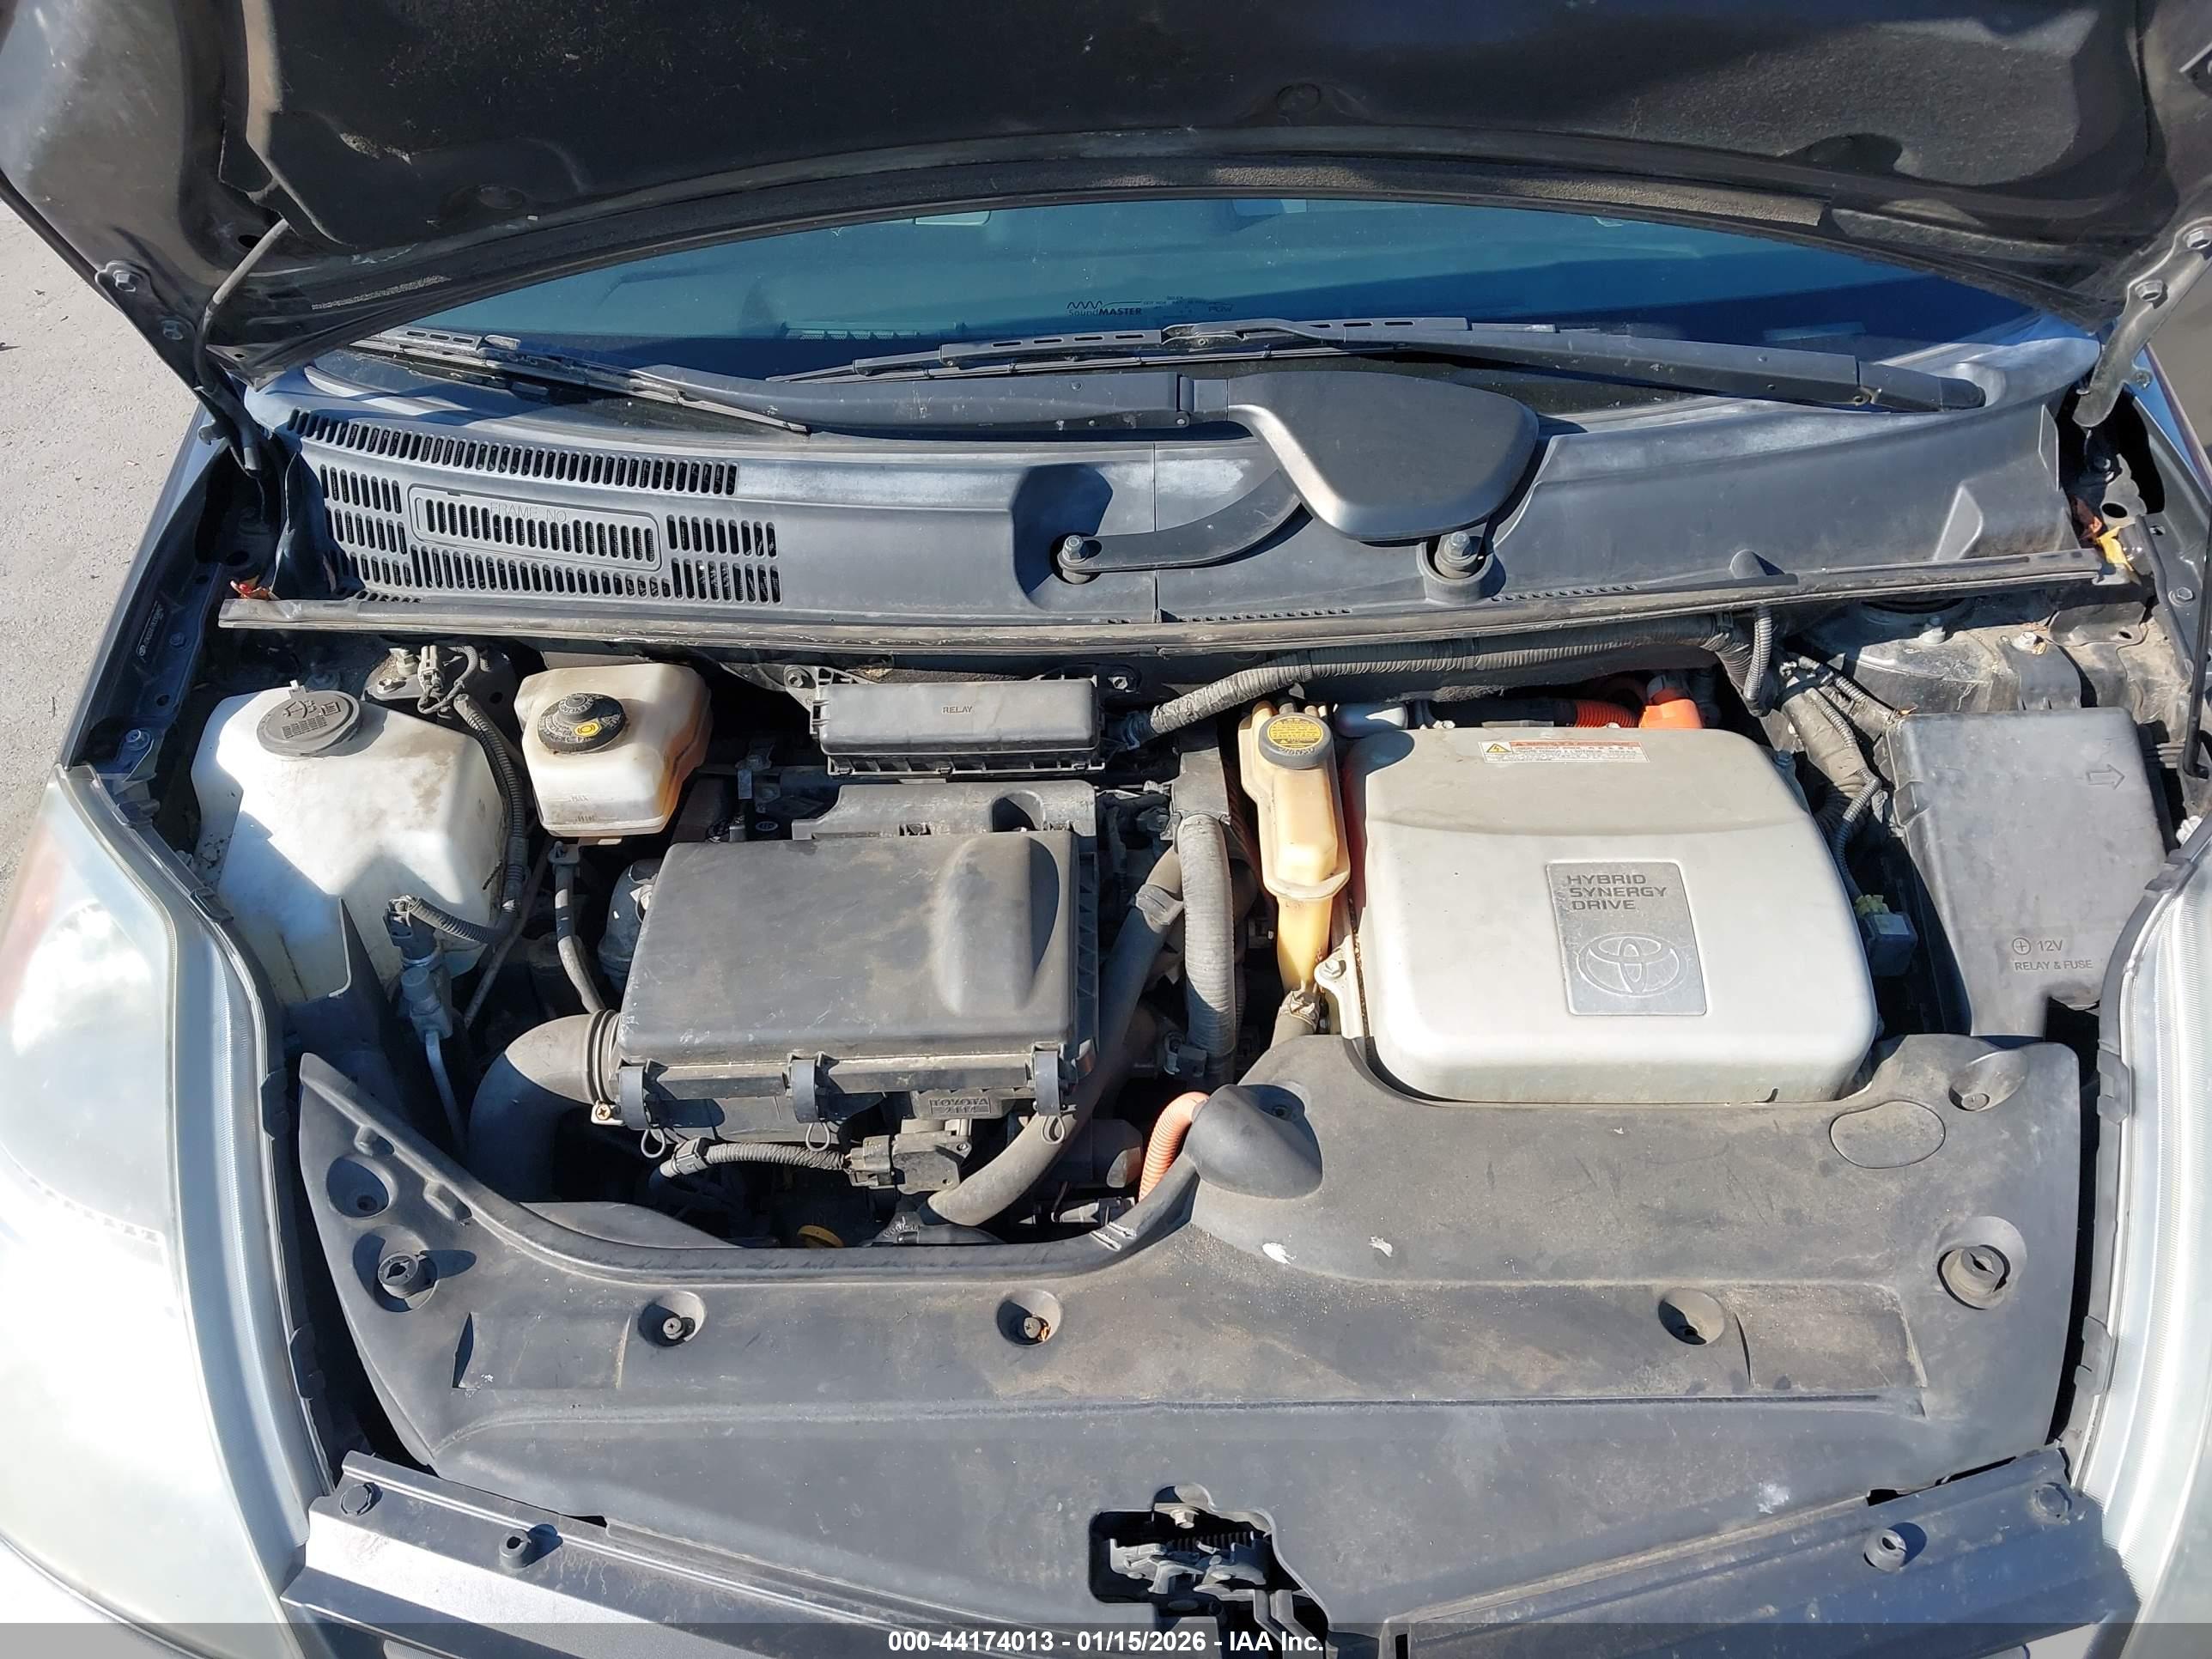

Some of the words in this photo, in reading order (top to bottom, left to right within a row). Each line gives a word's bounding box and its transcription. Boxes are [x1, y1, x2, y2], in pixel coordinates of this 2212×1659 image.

[490, 501, 538, 520] FRAME
[943, 705, 973, 714] RELAY
[1567, 874, 1647, 885] HYBRID
[1570, 886, 1668, 897] SYNERGY
[1572, 899, 1637, 910] DRIVE
[2038, 939, 2063, 951] 12V
[2014, 961, 2051, 971] RELAY
[2053, 961, 2062, 970] &
[2063, 959, 2094, 969] FUSE
[932, 1098, 989, 1107] TOYOTA
